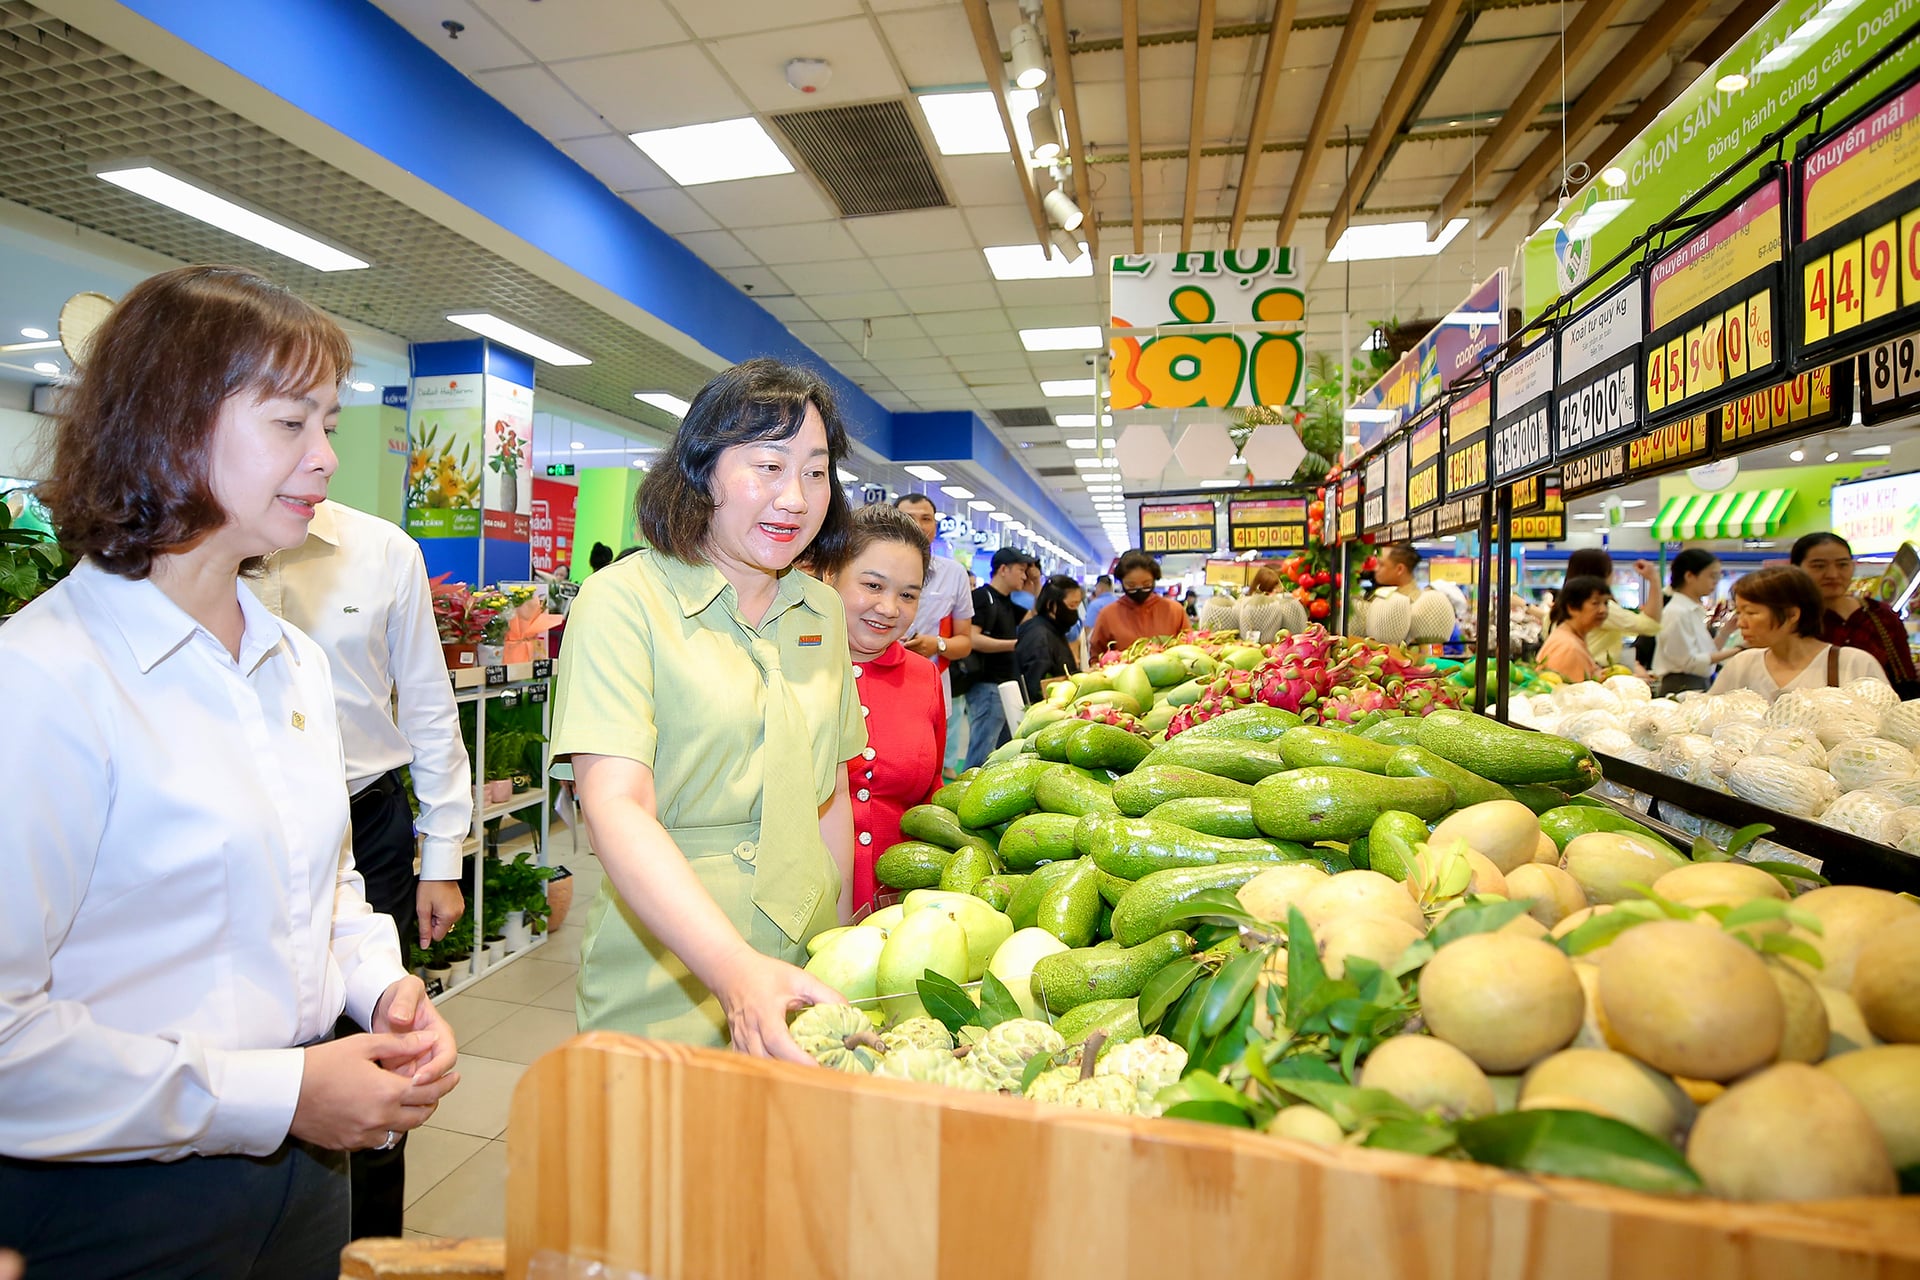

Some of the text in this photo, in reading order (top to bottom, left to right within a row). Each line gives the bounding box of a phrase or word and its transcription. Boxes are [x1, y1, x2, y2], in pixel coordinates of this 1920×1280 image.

[1743, 97, 1776, 136] hành
[1780, 66, 1818, 106] cùng
[1822, 39, 1852, 73] các
[1632, 127, 1678, 174] CHỌN
[1806, 126, 1865, 180] Khuyến
[1872, 96, 1904, 137] mãi
[1652, 247, 1688, 283] Khuyến
[1690, 231, 1710, 256] mãi
[1570, 321, 1587, 346] Xoài
[1616, 297, 1627, 316] kg
[1561, 379, 1618, 439] 42.900
[867, 489, 885, 502] 01
[941, 519, 956, 531] 03
